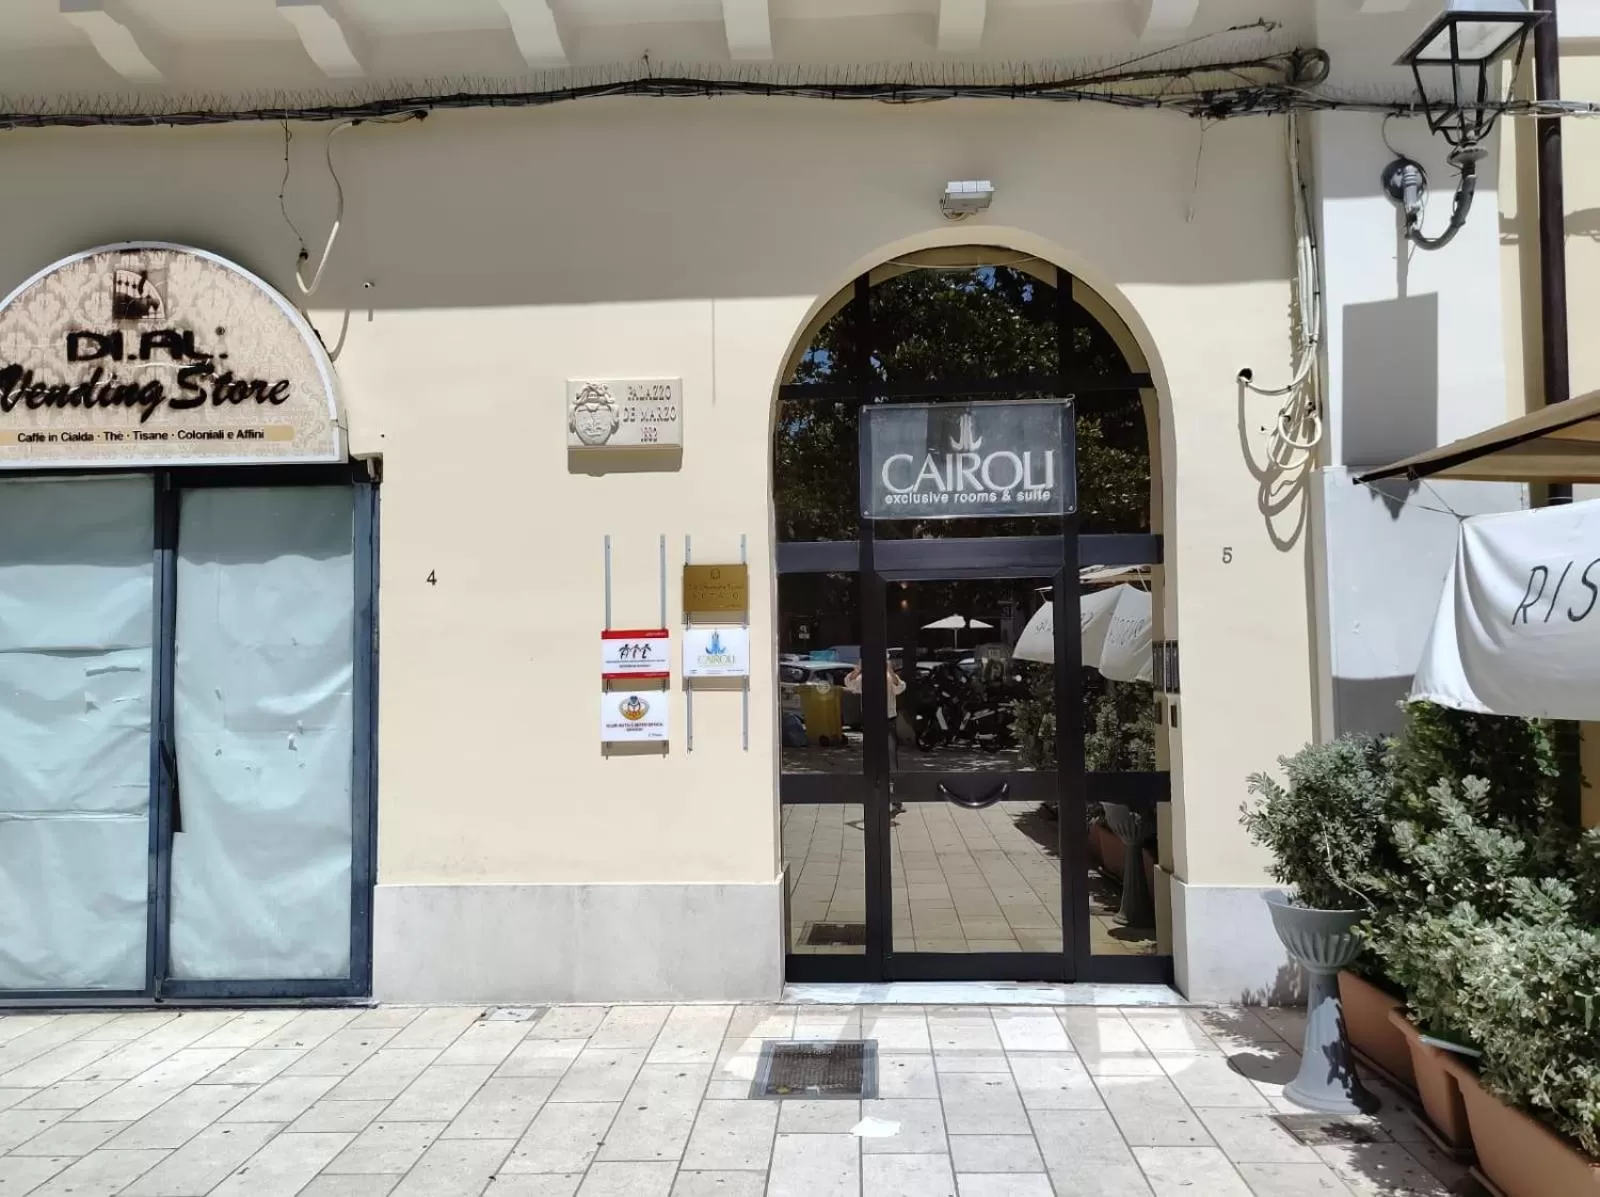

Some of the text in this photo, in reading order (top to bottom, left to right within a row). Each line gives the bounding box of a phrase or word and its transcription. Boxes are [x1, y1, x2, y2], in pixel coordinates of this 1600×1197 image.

[0, 362, 290, 423] Vending Store
[627, 384, 672, 401] PALAZZO
[622, 406, 677, 422] DE MARZO
[48, 432, 58, 442] in
[60, 432, 95, 442] Cialda
[132, 430, 169, 441] Tisane
[177, 429, 225, 440] Coloniali
[227, 431, 235, 439] e
[236, 429, 265, 440] Affini
[881, 450, 1055, 493] CAIROLI
[884, 487, 1052, 504] exclusive rooms & suite
[1222, 546, 1232, 564] 5
[426, 569, 437, 585] 4
